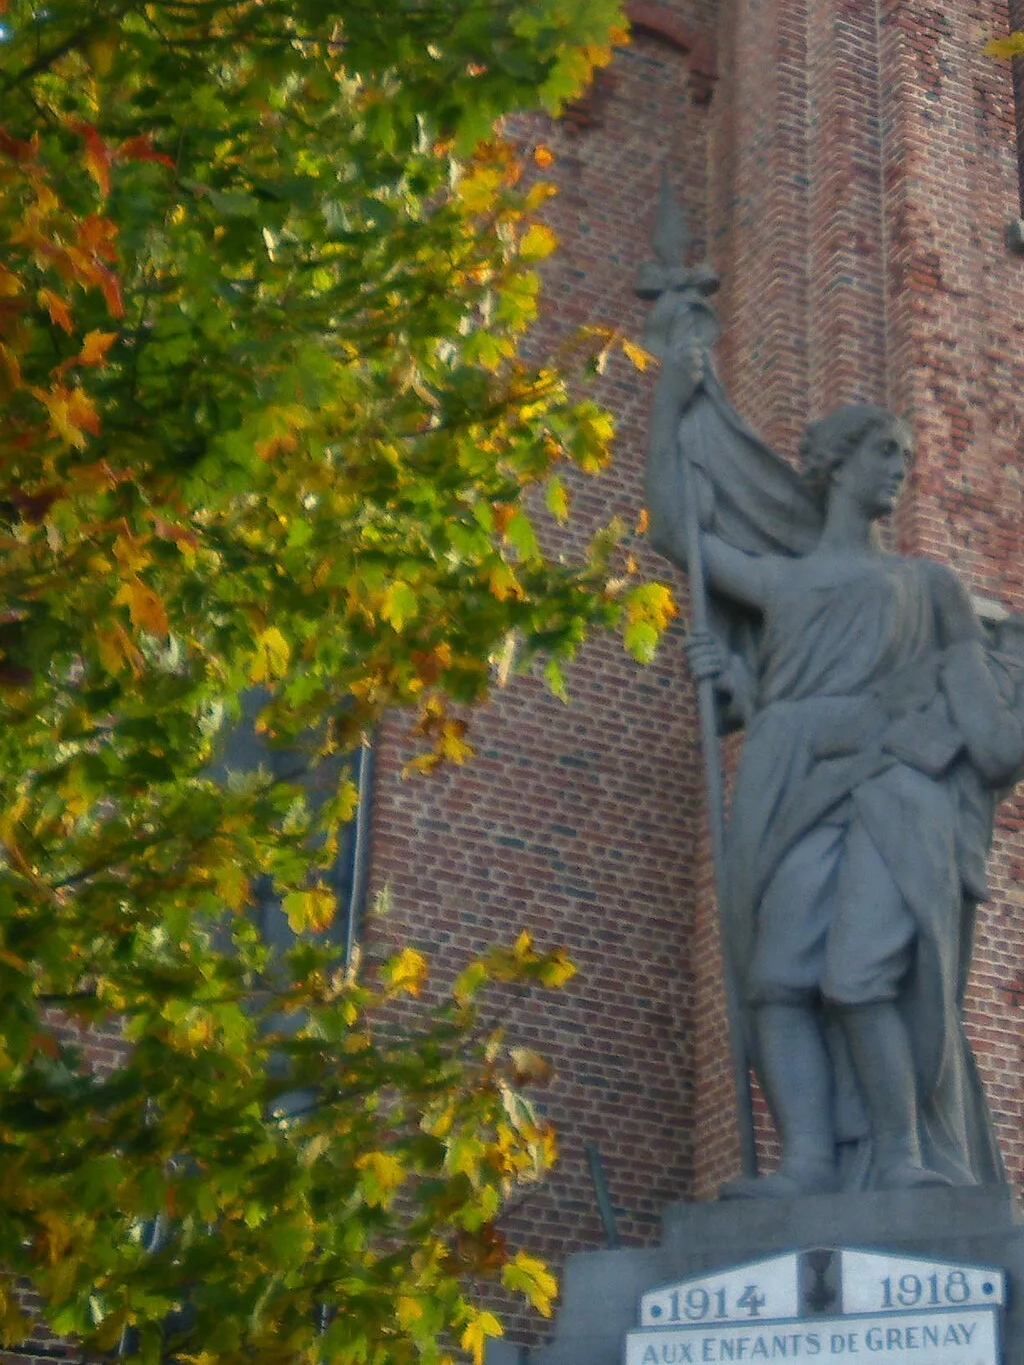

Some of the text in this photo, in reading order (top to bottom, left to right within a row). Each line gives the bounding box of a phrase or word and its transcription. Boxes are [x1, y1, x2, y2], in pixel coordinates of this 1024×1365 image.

[667, 1284, 766, 1322] 1914
[879, 1271, 972, 1309] 1918
[641, 1322, 977, 1365] AUX ENFANTS DE GRENAY
